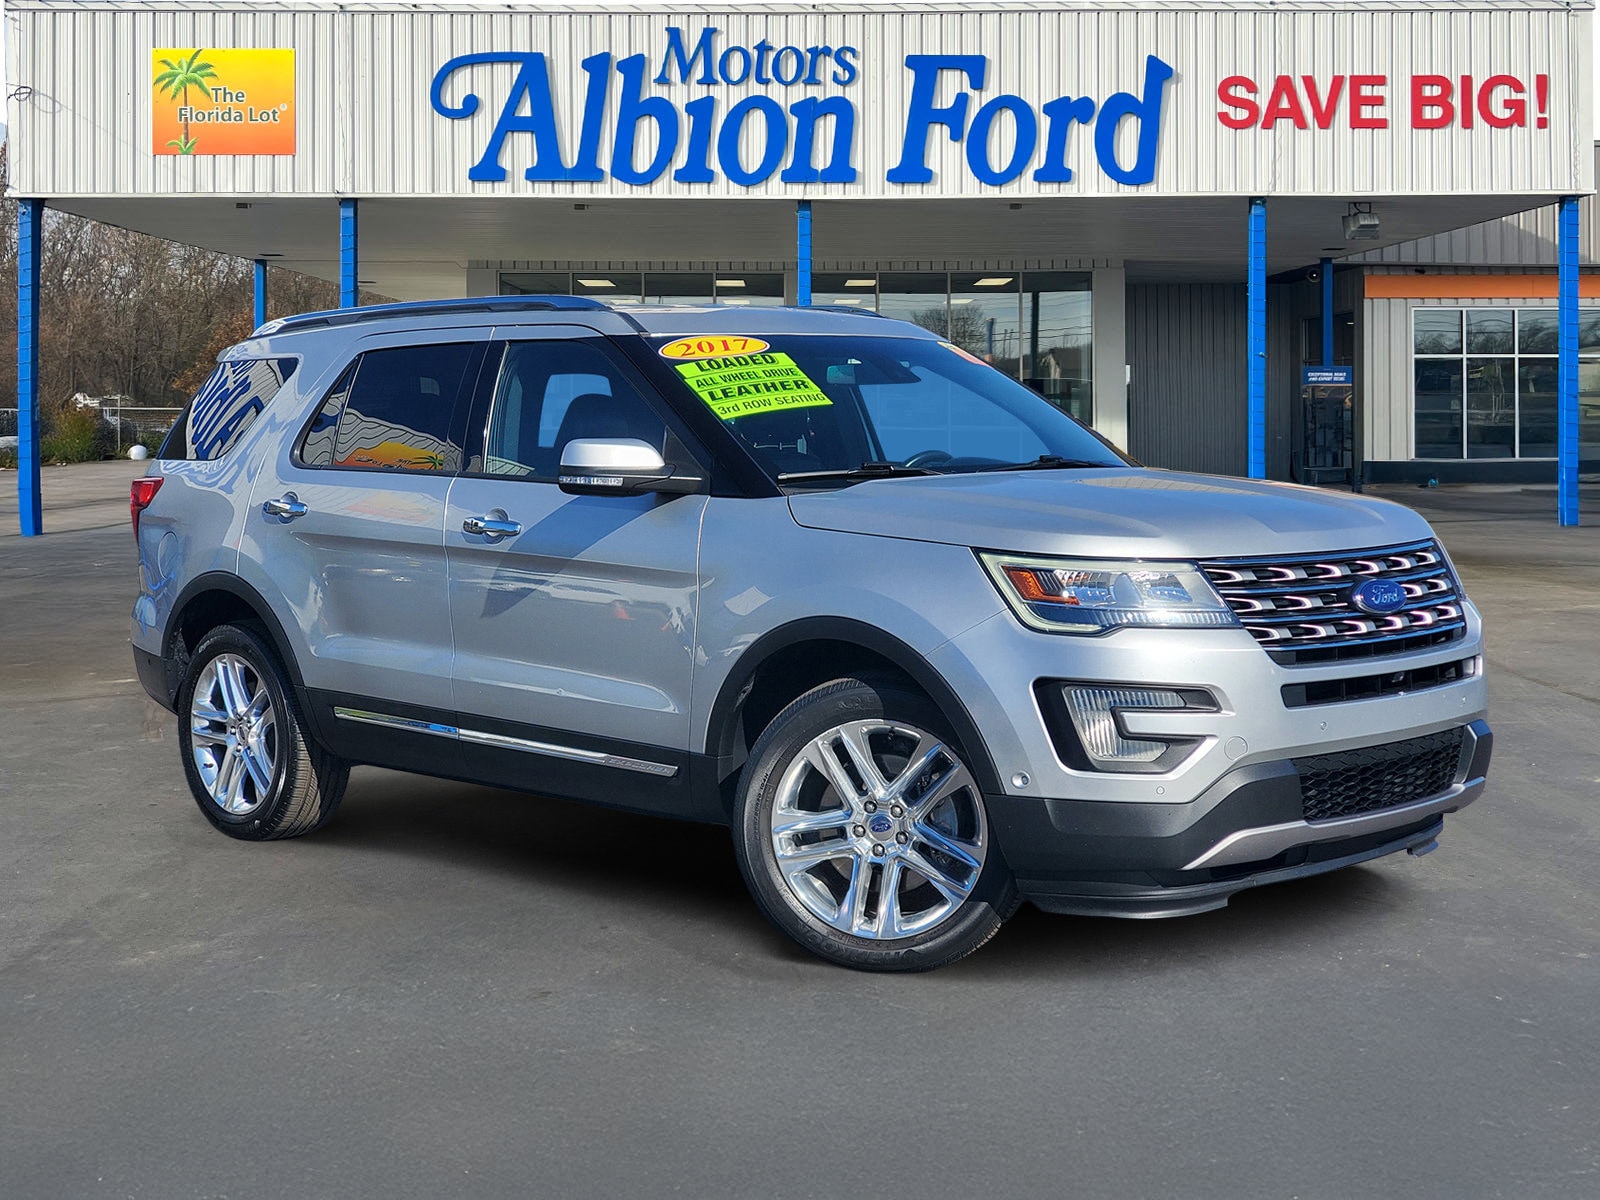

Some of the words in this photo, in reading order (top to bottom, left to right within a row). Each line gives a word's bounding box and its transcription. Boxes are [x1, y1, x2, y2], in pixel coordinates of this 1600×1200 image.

[655, 27, 857, 86] Motors
[211, 86, 245, 103] The
[1217, 74, 1388, 131] SAVE
[1411, 74, 1549, 131] BIG!
[178, 106, 244, 122] Florida
[430, 51, 857, 187] Albion
[886, 54, 1173, 187] Ford
[676, 338, 749, 357] 2017
[695, 354, 777, 373] LOADED
[695, 378, 719, 389] ALL
[719, 370, 761, 383] WHEEL
[763, 367, 798, 379] DRIVE
[706, 379, 810, 402] LEATHER
[717, 404, 741, 416] 3rd
[743, 399, 774, 411] ROW
[776, 393, 826, 406] SEATING
[1371, 584, 1399, 604] Ford
